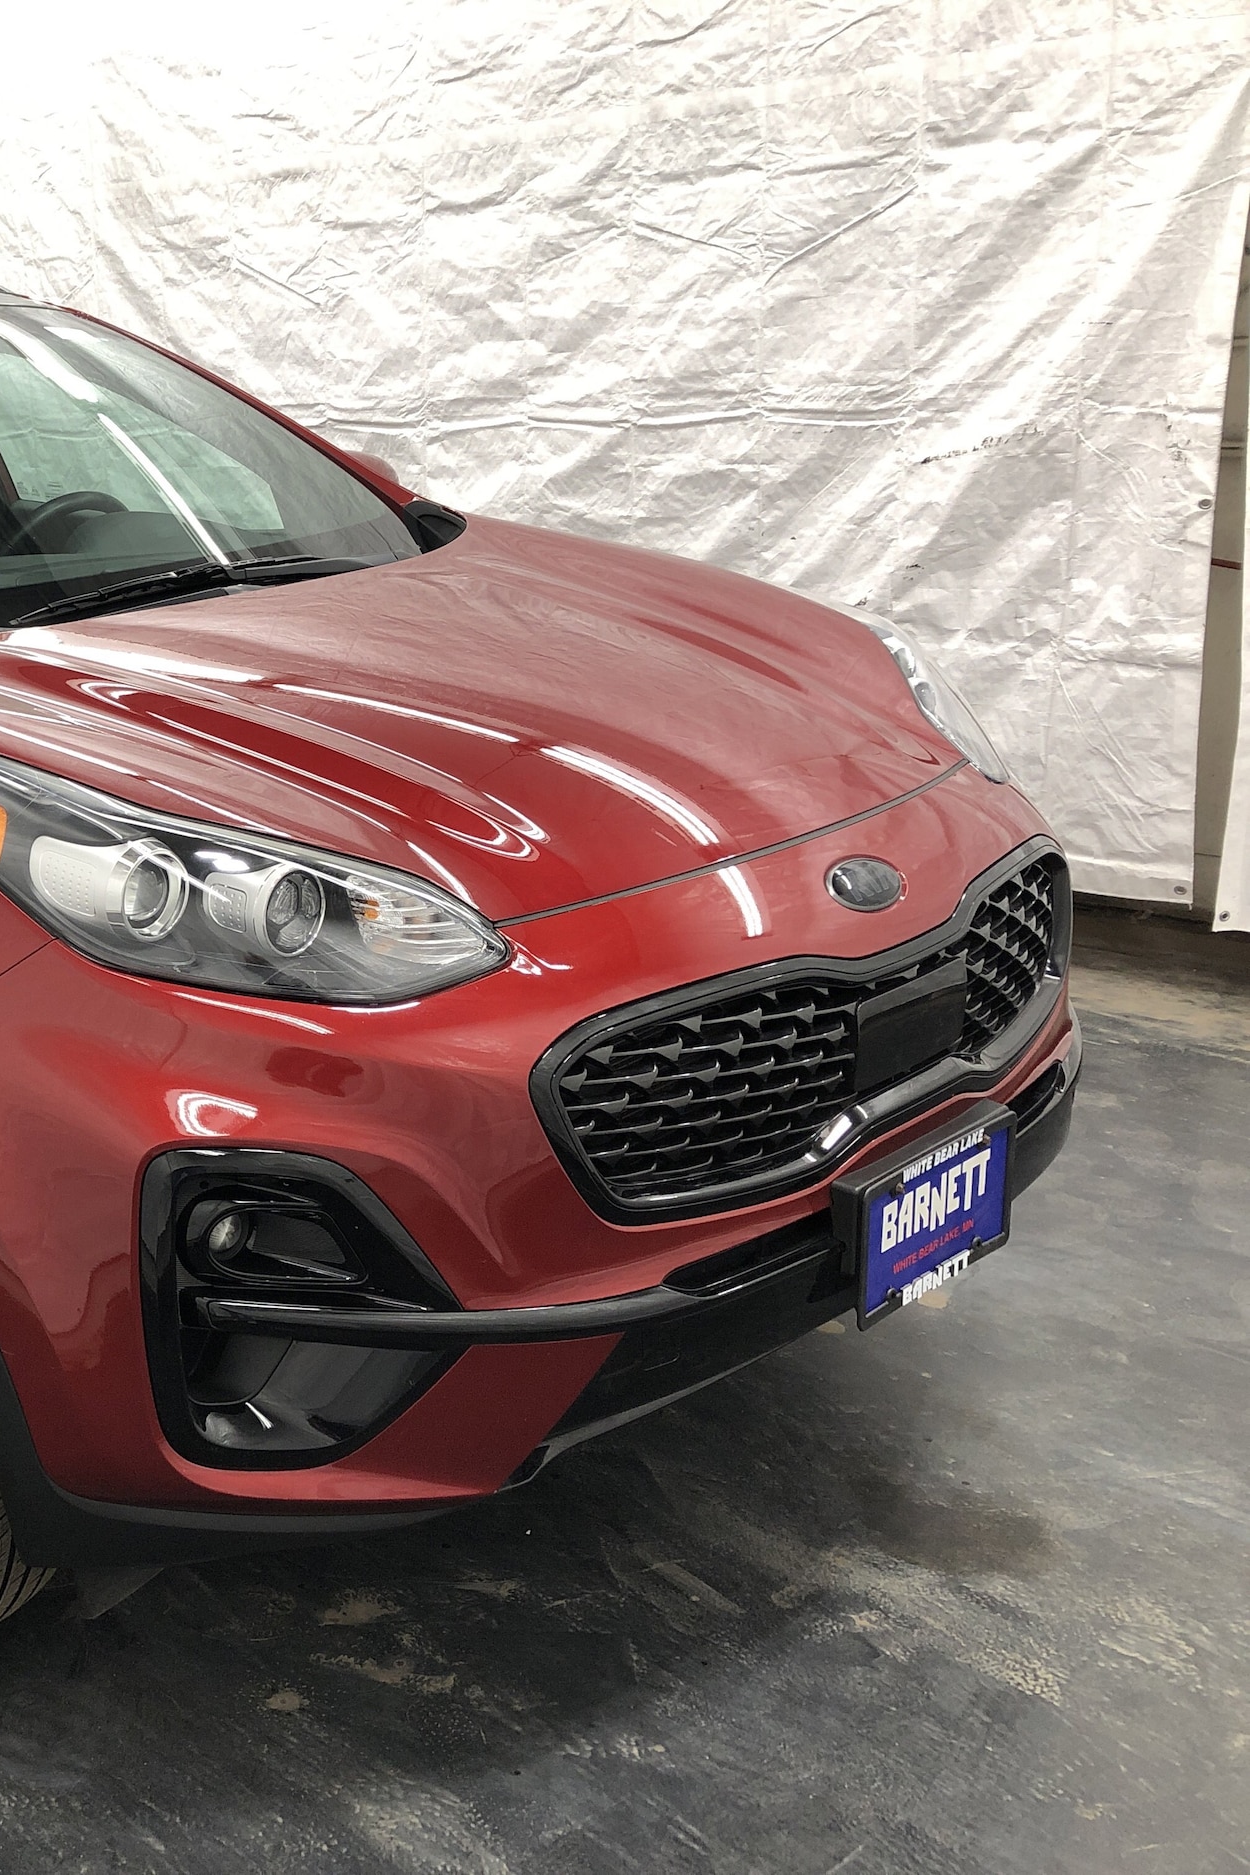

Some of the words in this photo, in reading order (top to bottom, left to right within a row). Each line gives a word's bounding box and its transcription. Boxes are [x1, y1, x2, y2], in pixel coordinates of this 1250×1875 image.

[846, 864, 899, 902] KIA
[903, 1158, 932, 1183] WHITE
[934, 1145, 959, 1169] BEAR
[960, 1128, 985, 1152] LAKE
[880, 1148, 991, 1253] BARNETT
[893, 1255, 918, 1274] WHITE
[918, 1242, 939, 1260] BEAR
[962, 1219, 974, 1233] MN
[901, 1249, 971, 1307] BARNETT
